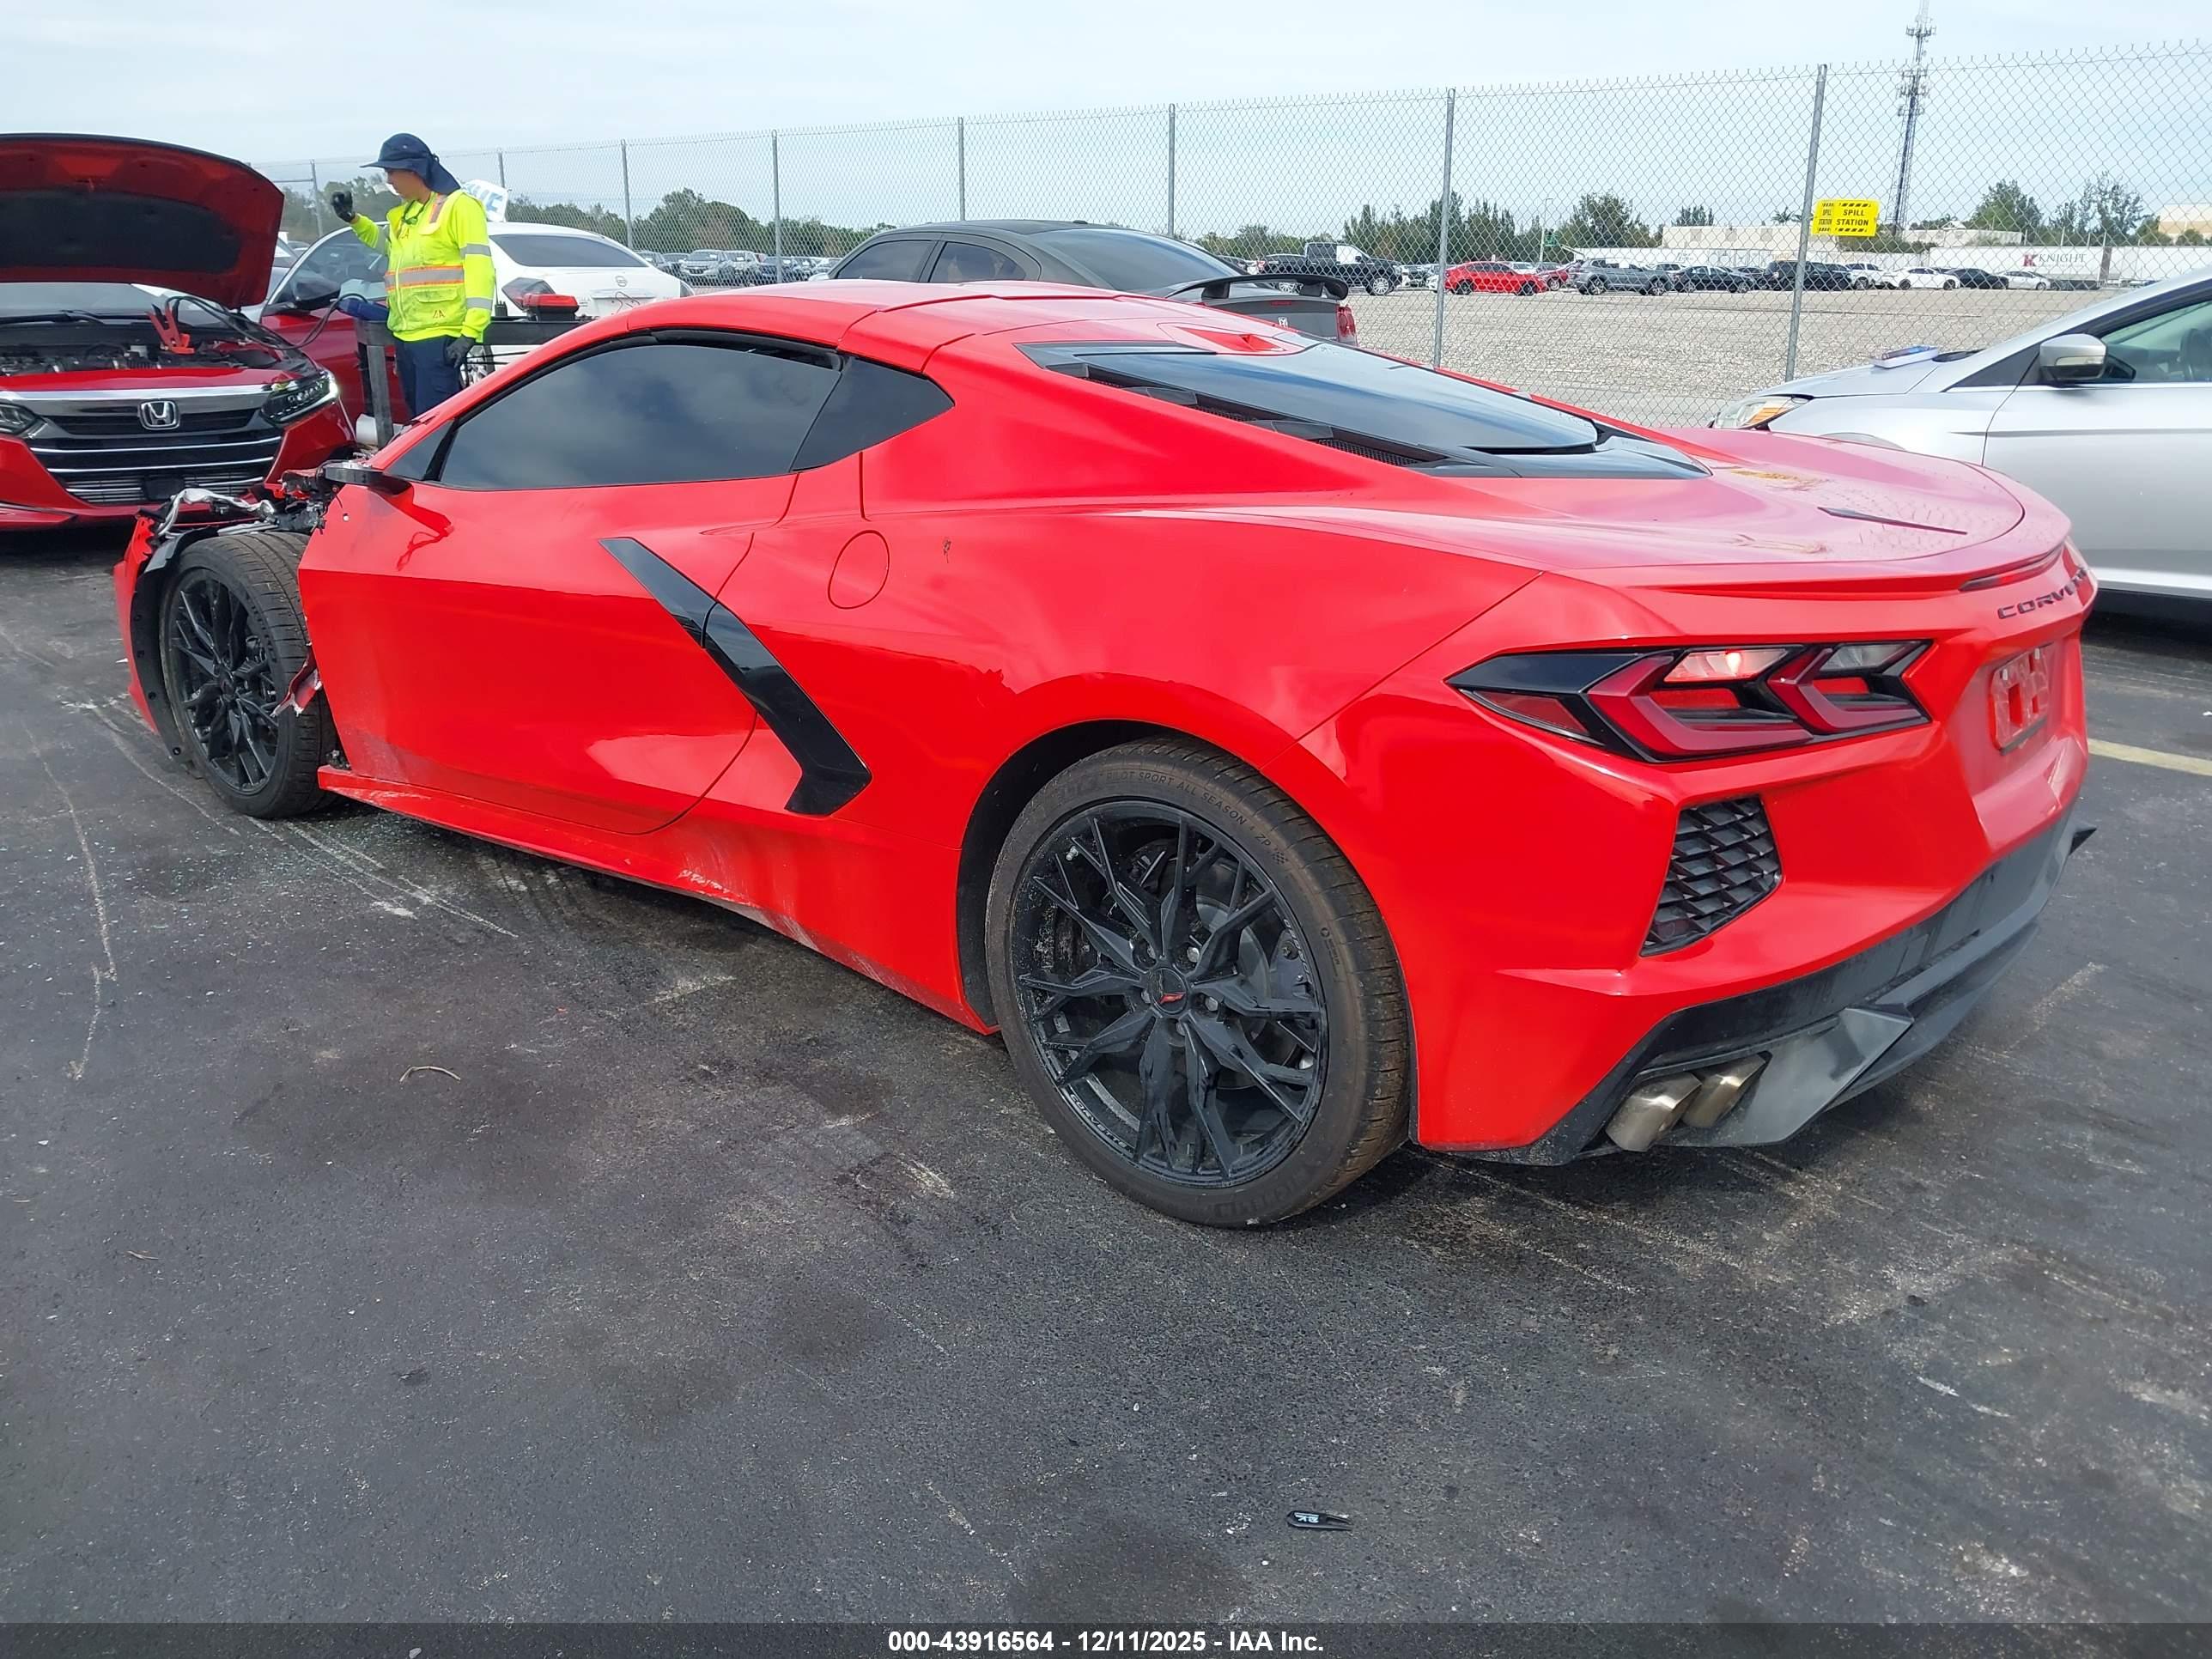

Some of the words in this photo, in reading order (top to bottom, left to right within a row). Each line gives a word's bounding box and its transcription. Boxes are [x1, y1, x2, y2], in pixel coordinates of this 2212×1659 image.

[2039, 253, 2087, 263] KNIGHT
[1139, 771, 1175, 785] SPORT
[1176, 781, 1196, 796] ALL
[1200, 792, 1247, 825] SEASON
[1255, 833, 1272, 847] ZP
[1069, 1092, 1128, 1149] CORVETTE
